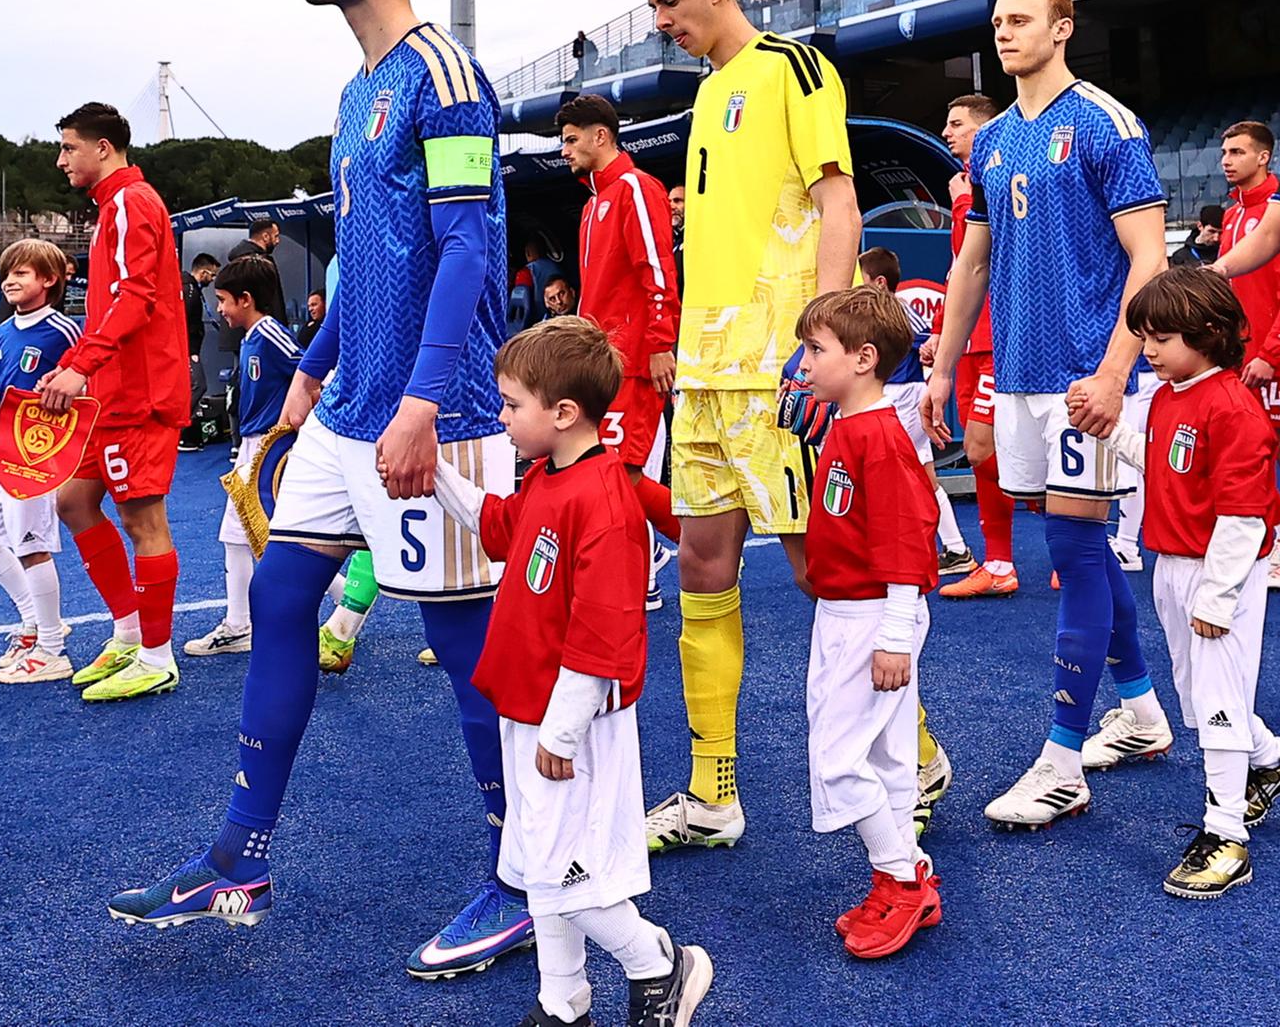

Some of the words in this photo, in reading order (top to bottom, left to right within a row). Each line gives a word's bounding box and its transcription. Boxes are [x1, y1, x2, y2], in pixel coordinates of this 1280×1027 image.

[621, 132, 680, 153] figcstore.com
[698, 147, 708, 195] 1
[881, 169, 918, 187] ITALIA
[1010, 173, 1028, 219] 6
[973, 374, 995, 408] 5
[104, 444, 129, 481] 6
[1060, 428, 1084, 477] 6
[830, 470, 852, 486] ITALIA
[784, 466, 799, 520] 1
[401, 509, 427, 572] 5
[537, 537, 557, 557] ITALIA
[1207, 720, 1232, 728] adidas
[477, 782, 501, 791] LIA
[561, 873, 591, 888] adidas
